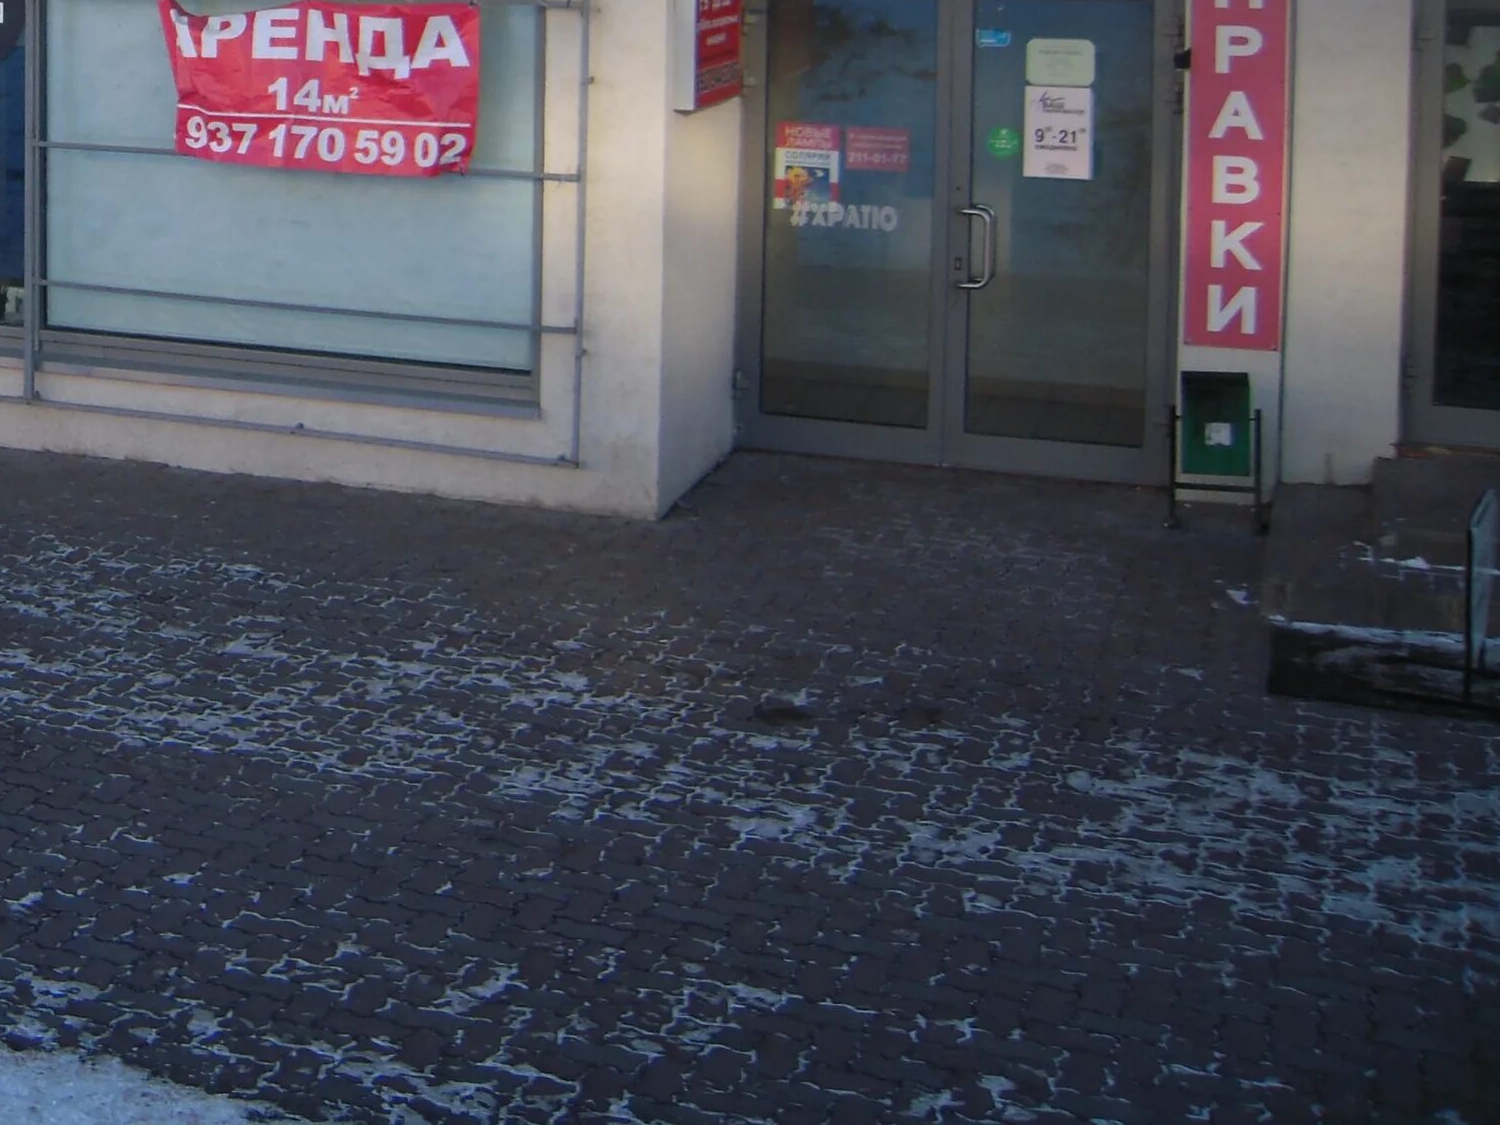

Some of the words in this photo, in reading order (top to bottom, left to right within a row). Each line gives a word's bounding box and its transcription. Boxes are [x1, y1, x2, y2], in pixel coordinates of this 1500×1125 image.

[185, 115, 258, 154] 937
[269, 124, 346, 163] 170
[355, 130, 406, 165] 59
[414, 132, 468, 168] 02
